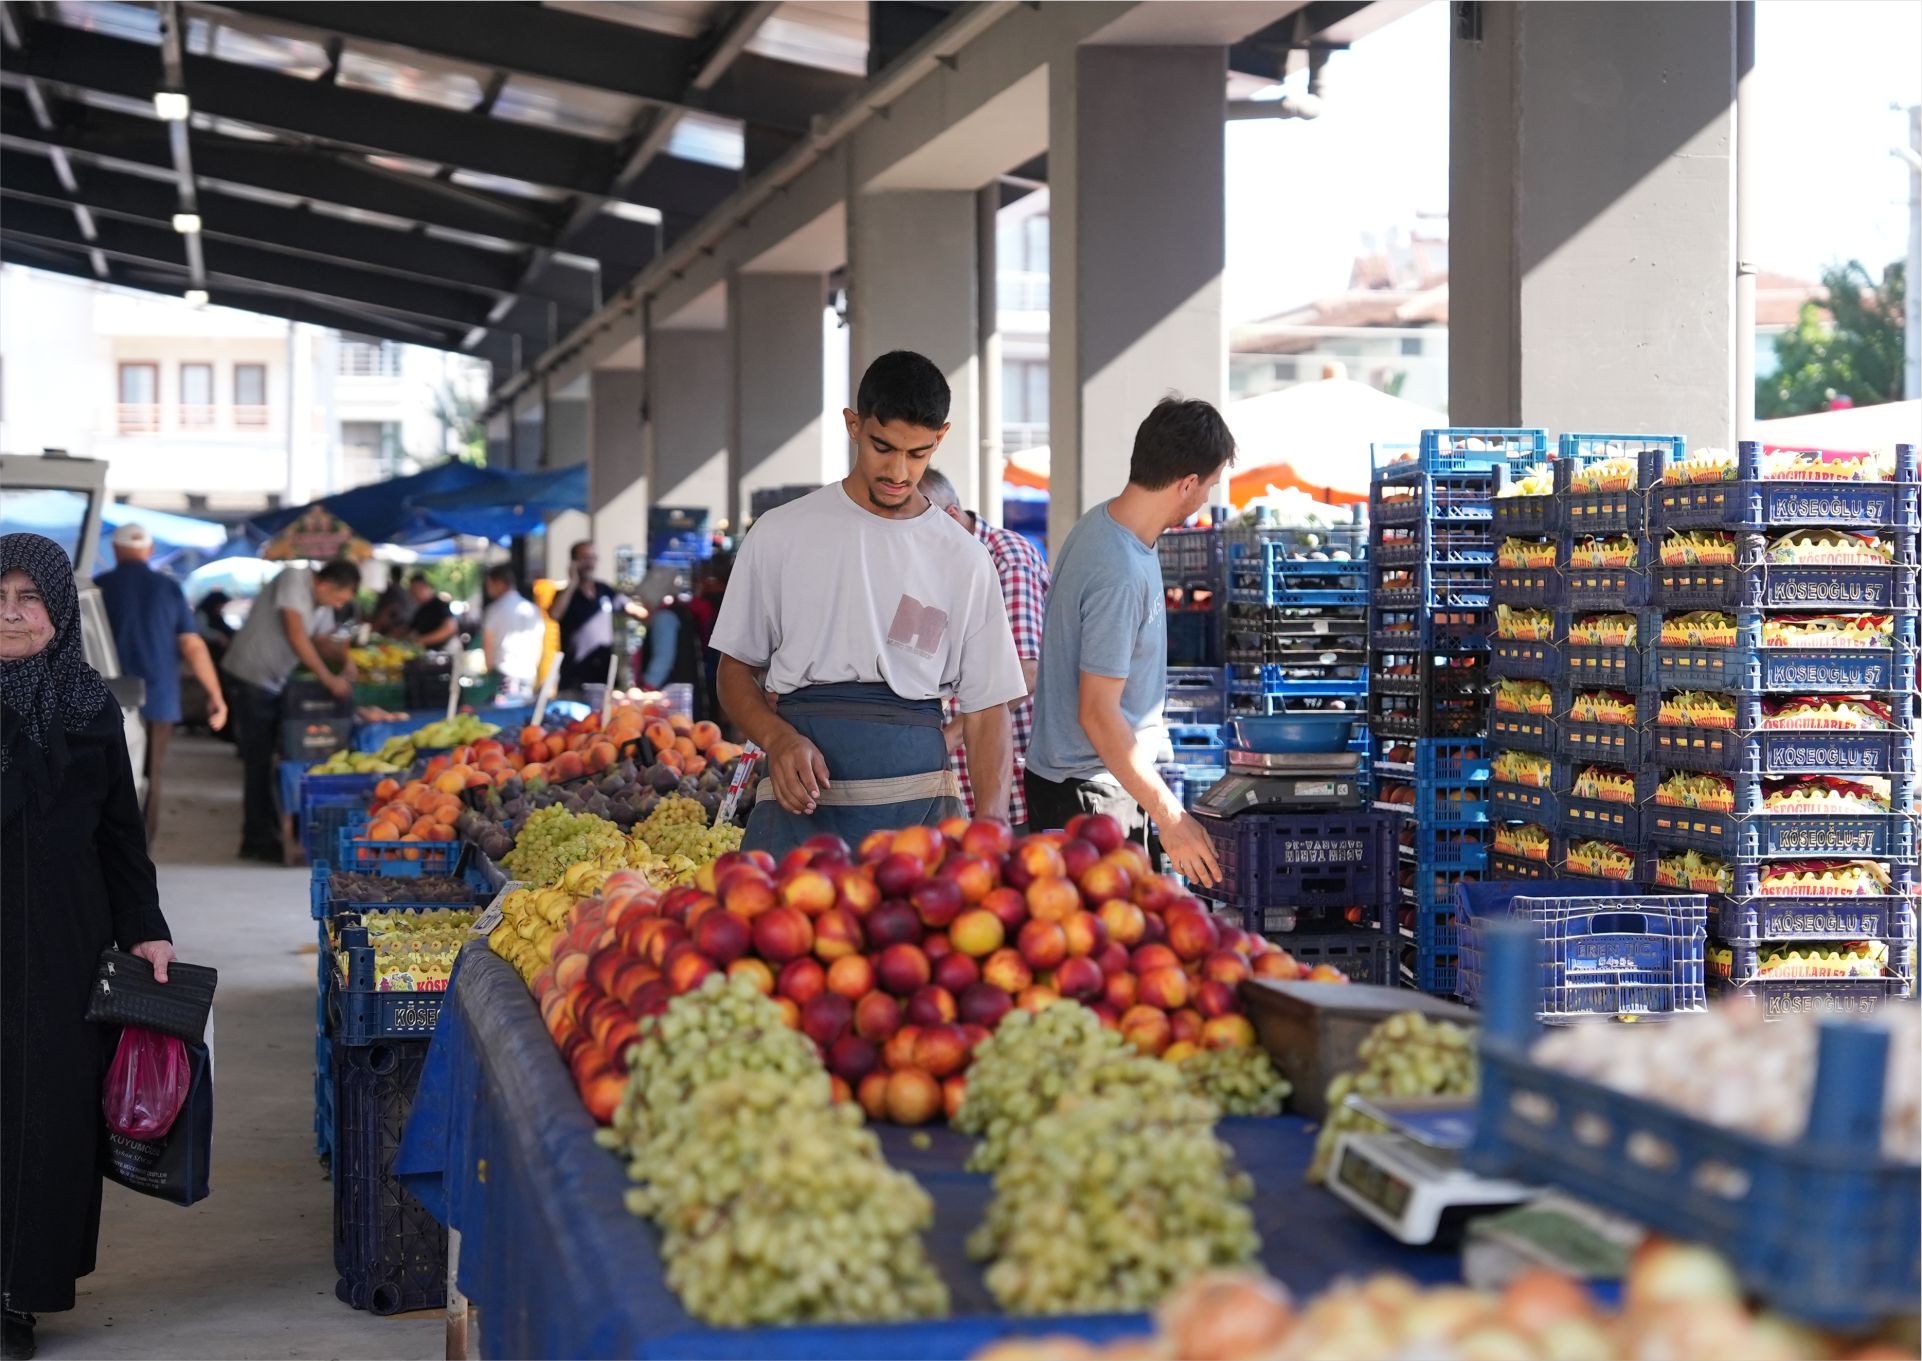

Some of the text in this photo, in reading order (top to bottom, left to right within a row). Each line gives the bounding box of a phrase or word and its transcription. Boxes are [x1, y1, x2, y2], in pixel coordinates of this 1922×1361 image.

[1776, 494, 1886, 518] KÖSEOĞLU 57
[1774, 578, 1883, 601] KÖSEOĞLU 57
[1864, 665, 1882, 683] 57
[1773, 744, 1879, 765] KÖSEOĞLU 57
[1779, 827, 1875, 848] KÖSEOĞLU-57
[1771, 910, 1880, 932] KÖSEOĞLU 57
[1768, 992, 1878, 1013] KÖSEOĞLU 57
[395, 1004, 441, 1026] KÖSE
